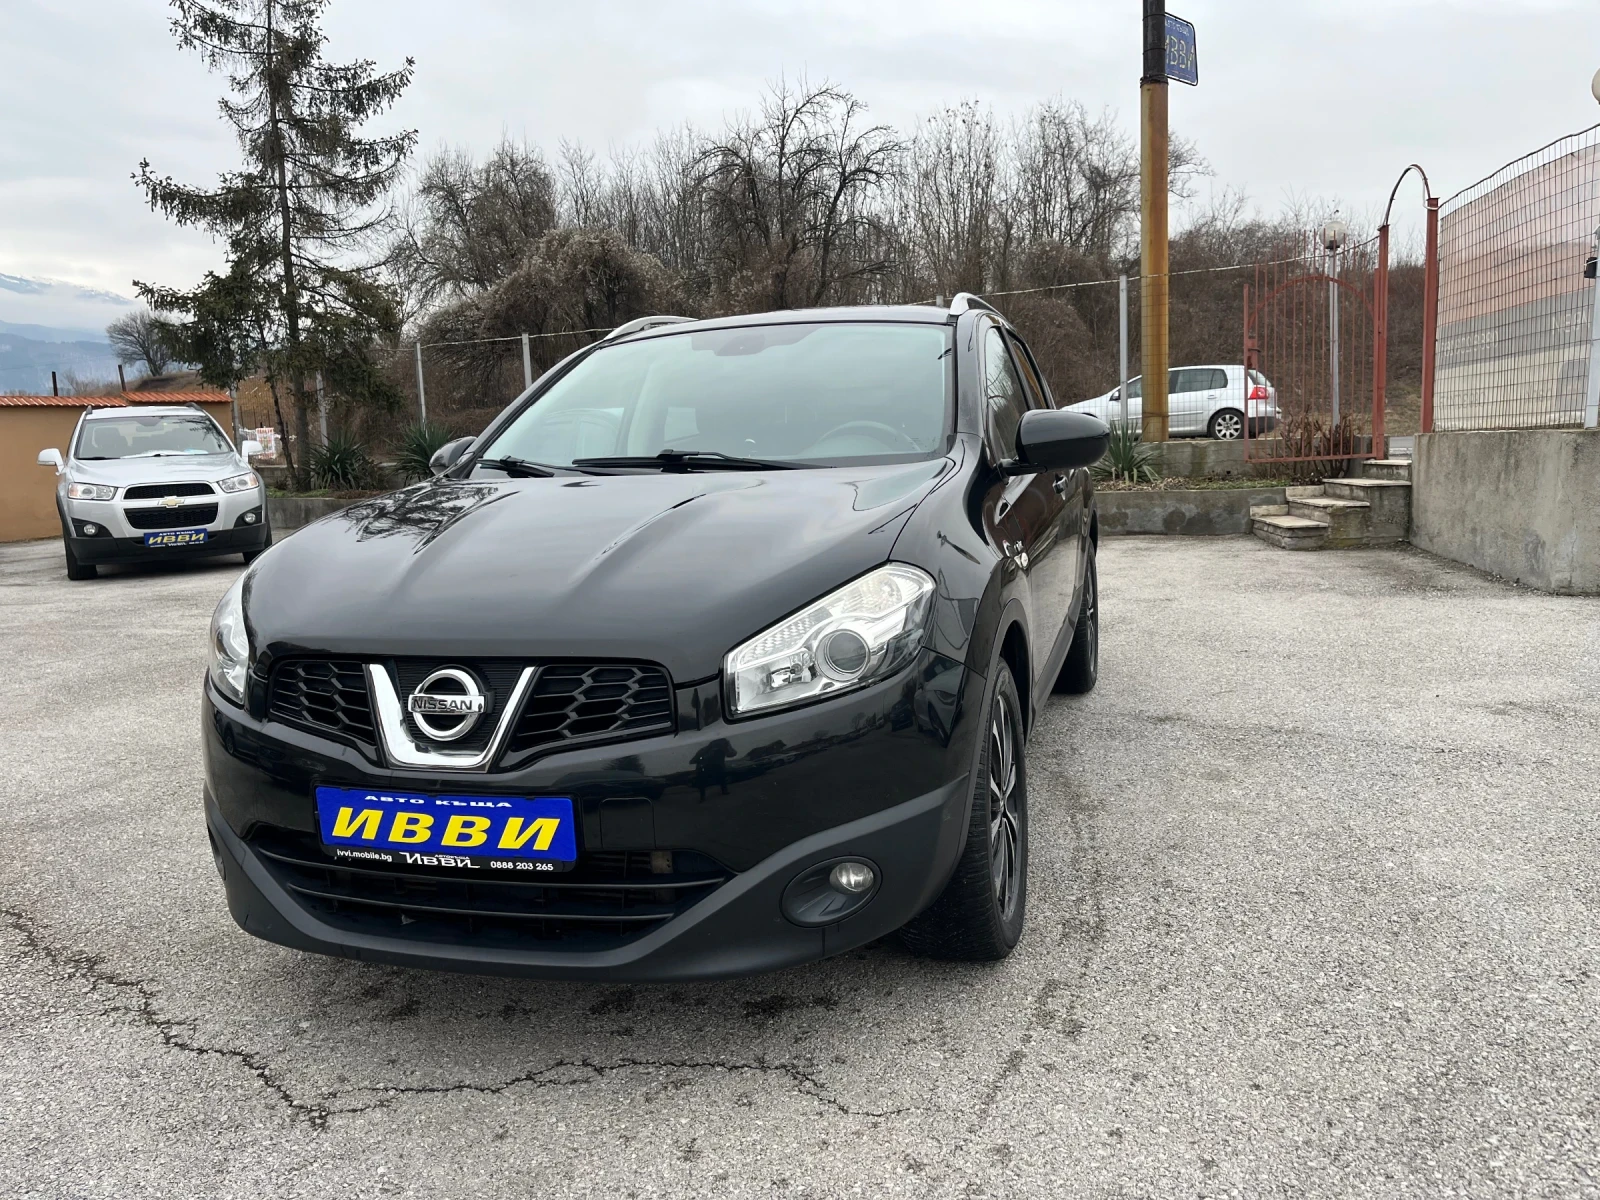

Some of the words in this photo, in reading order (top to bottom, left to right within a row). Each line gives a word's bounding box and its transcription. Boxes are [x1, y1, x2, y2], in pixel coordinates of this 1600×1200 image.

[148, 533, 205, 544] ИВВИ
[413, 699, 472, 711] NISSAN
[365, 795, 424, 804] АВТО
[436, 800, 512, 808] КЪЩА
[332, 806, 560, 851] ИВВИ
[490, 860, 514, 869] 0888
[516, 862, 534, 870] 203
[535, 863, 554, 871] 265
